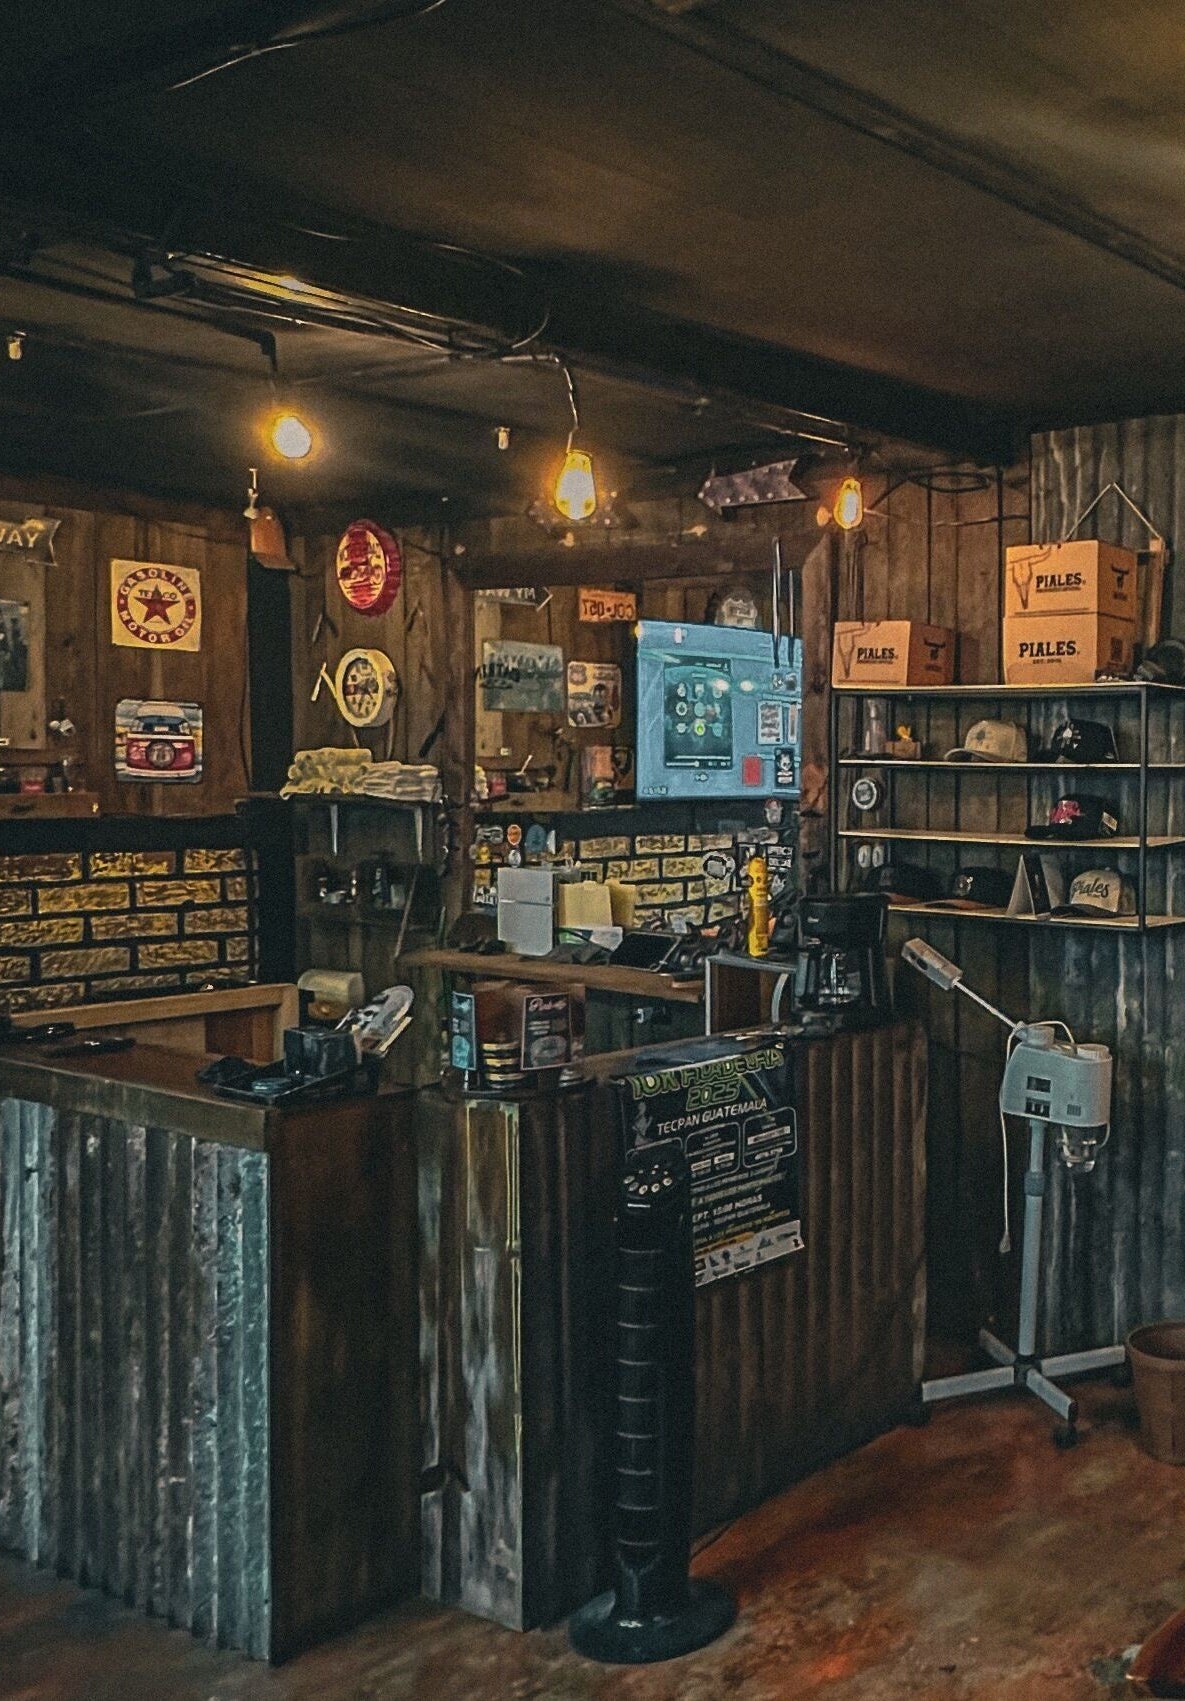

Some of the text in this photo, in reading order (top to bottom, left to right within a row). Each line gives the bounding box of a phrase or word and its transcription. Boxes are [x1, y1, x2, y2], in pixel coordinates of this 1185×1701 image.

[0, 528, 39, 548] AY
[120, 568, 193, 600] GASOLINE
[1036, 573, 1083, 589] PIALES
[138, 589, 178, 601] TECO
[120, 610, 194, 643] MOTOR OIL
[857, 647, 896, 660] PIALES
[1019, 640, 1077, 658] PIALES
[685, 1078, 741, 1112] 2025
[657, 1098, 768, 1137] TECPAN GUATEMALA
